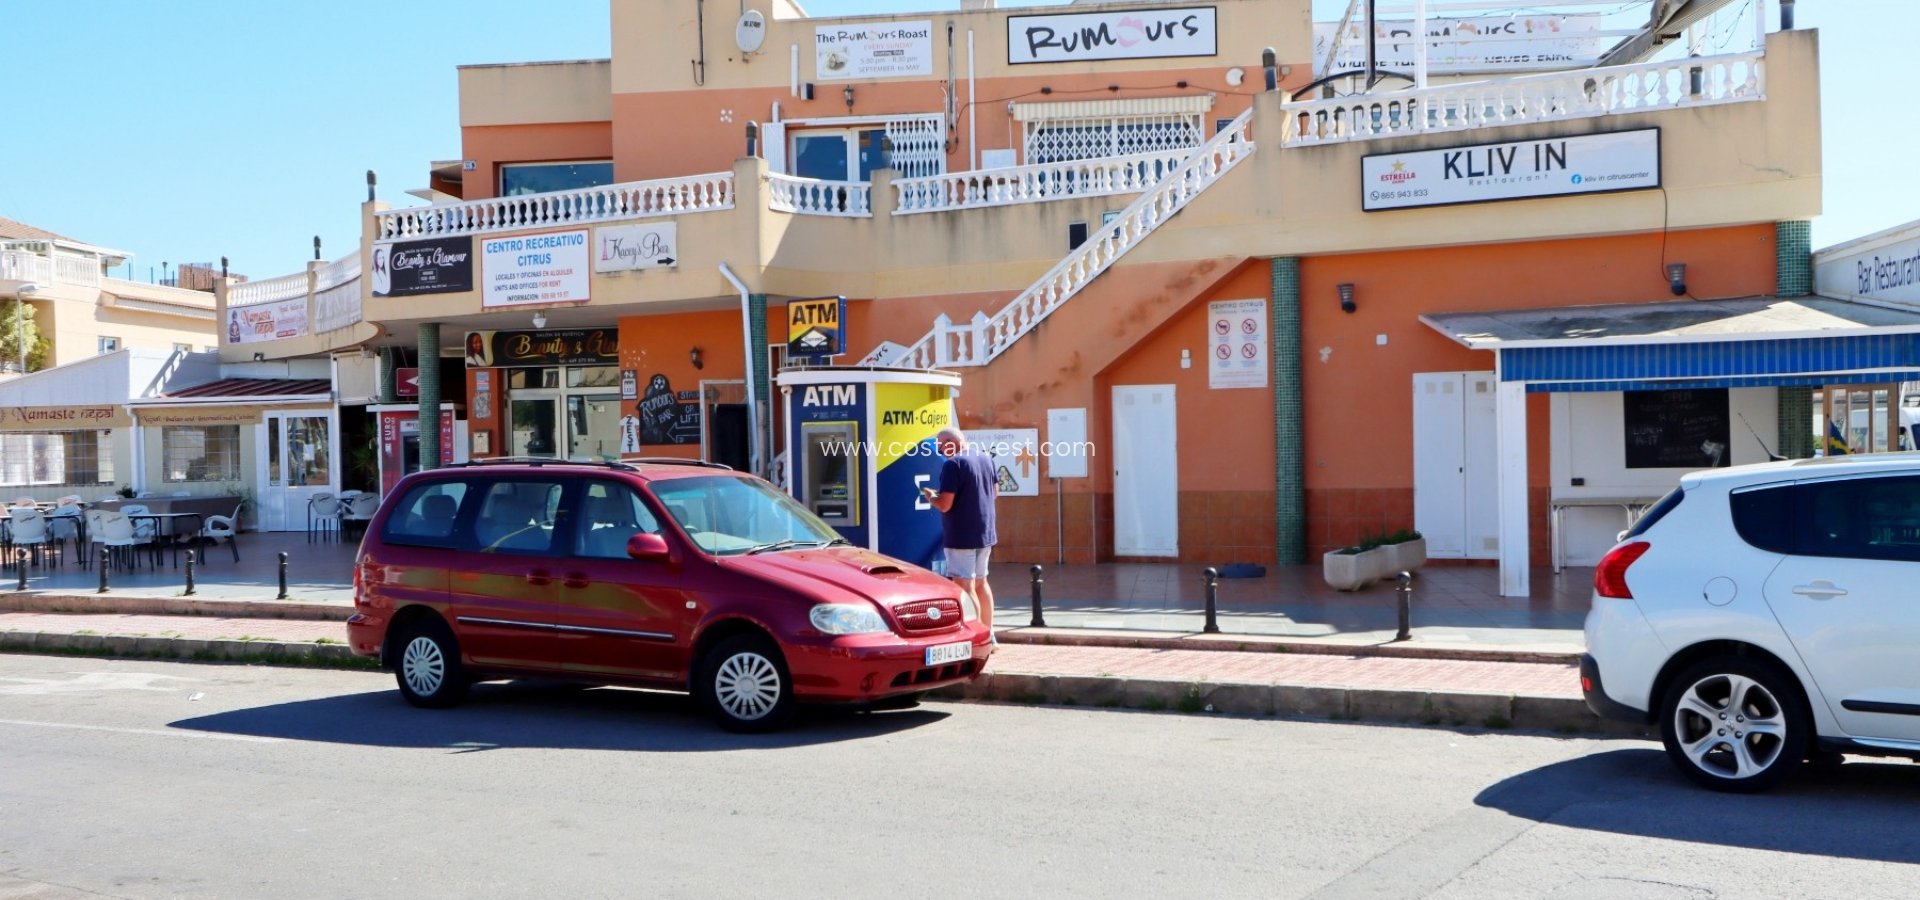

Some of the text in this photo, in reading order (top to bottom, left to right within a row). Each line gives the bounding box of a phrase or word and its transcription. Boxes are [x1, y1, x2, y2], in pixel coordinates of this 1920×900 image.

[816, 34, 835, 44] The
[898, 29, 928, 39] Roast
[864, 42, 886, 50] EVERY
[858, 64, 896, 73] SEPTEMBER
[1443, 141, 1567, 180] KLIV IN
[1380, 172, 1416, 182] ESTRELLA
[1469, 174, 1549, 186] Restaurant
[486, 234, 584, 254] CENTRO RECREATIVO
[642, 232, 670, 258] Bar
[391, 251, 424, 271] Beauty
[432, 247, 467, 267] Glamour
[517, 253, 552, 267] CITRUS
[495, 272, 516, 281] LOCALES
[520, 270, 542, 279] OFICINAS
[494, 284, 508, 292] UNITS
[508, 283, 519, 291] AND
[519, 281, 538, 290] OFFICES
[549, 280, 561, 288] RENT
[792, 302, 837, 326] ATM
[504, 334, 569, 360] Beauty
[803, 384, 857, 407] ATM
[12, 405, 114, 424] Namaste nepal
[658, 409, 674, 424] BAR
[680, 413, 700, 424] LIFT
[882, 409, 948, 428] ATM Cajero
[626, 415, 634, 453] ZEST
[993, 433, 1015, 441] Sports
